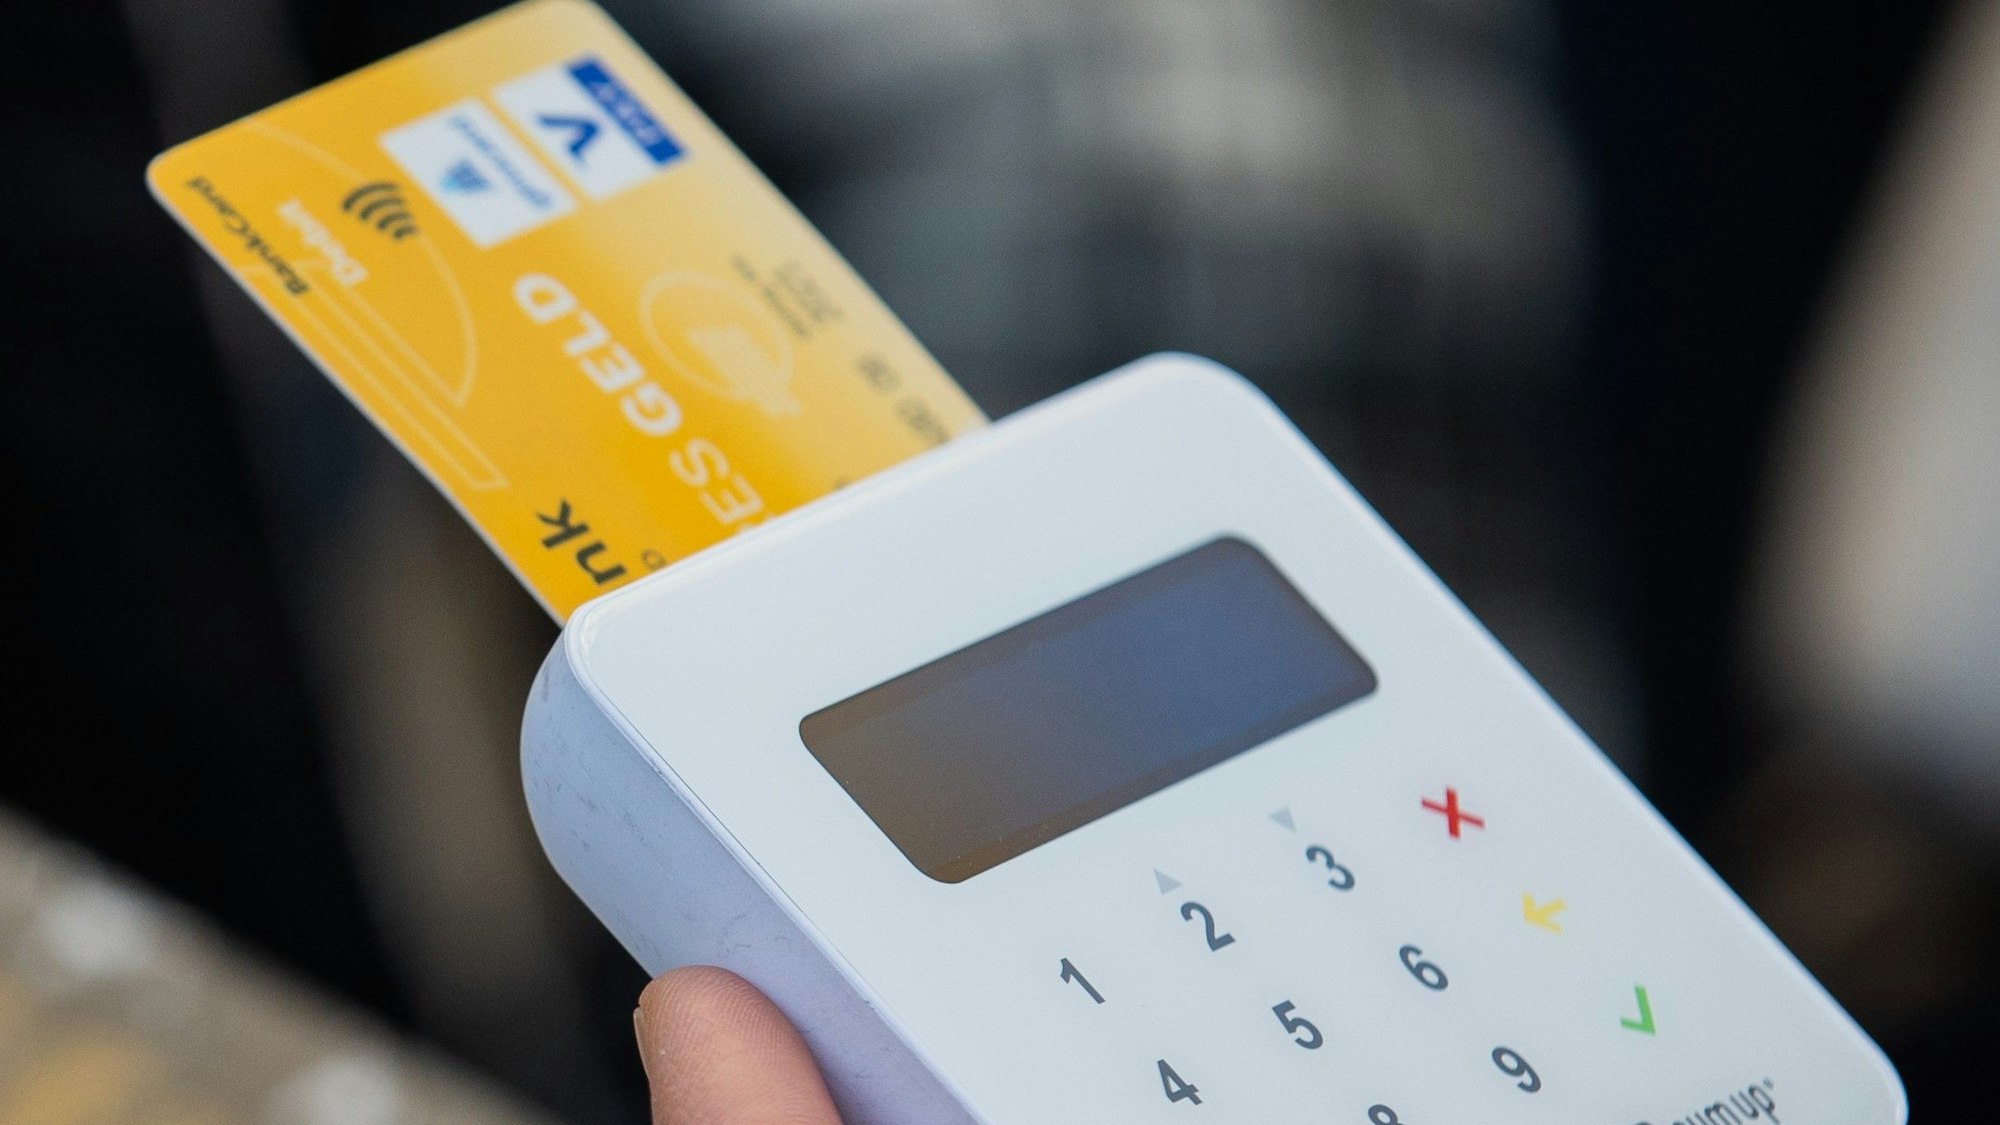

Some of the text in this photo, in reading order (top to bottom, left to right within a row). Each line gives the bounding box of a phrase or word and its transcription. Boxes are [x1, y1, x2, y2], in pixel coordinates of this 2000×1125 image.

[187, 176, 309, 295] BankCard
[278, 199, 368, 286] Debit
[514, 273, 683, 436] GELD
[669, 438, 777, 535] ES
[1306, 845, 1355, 891] 3
[1180, 901, 1235, 952] 2
[1060, 957, 1106, 1004] 1
[1399, 944, 1449, 991] 6
[1272, 1000, 1323, 1049] 5
[1157, 1059, 1203, 1105] 4
[1491, 1047, 1541, 1093] 9
